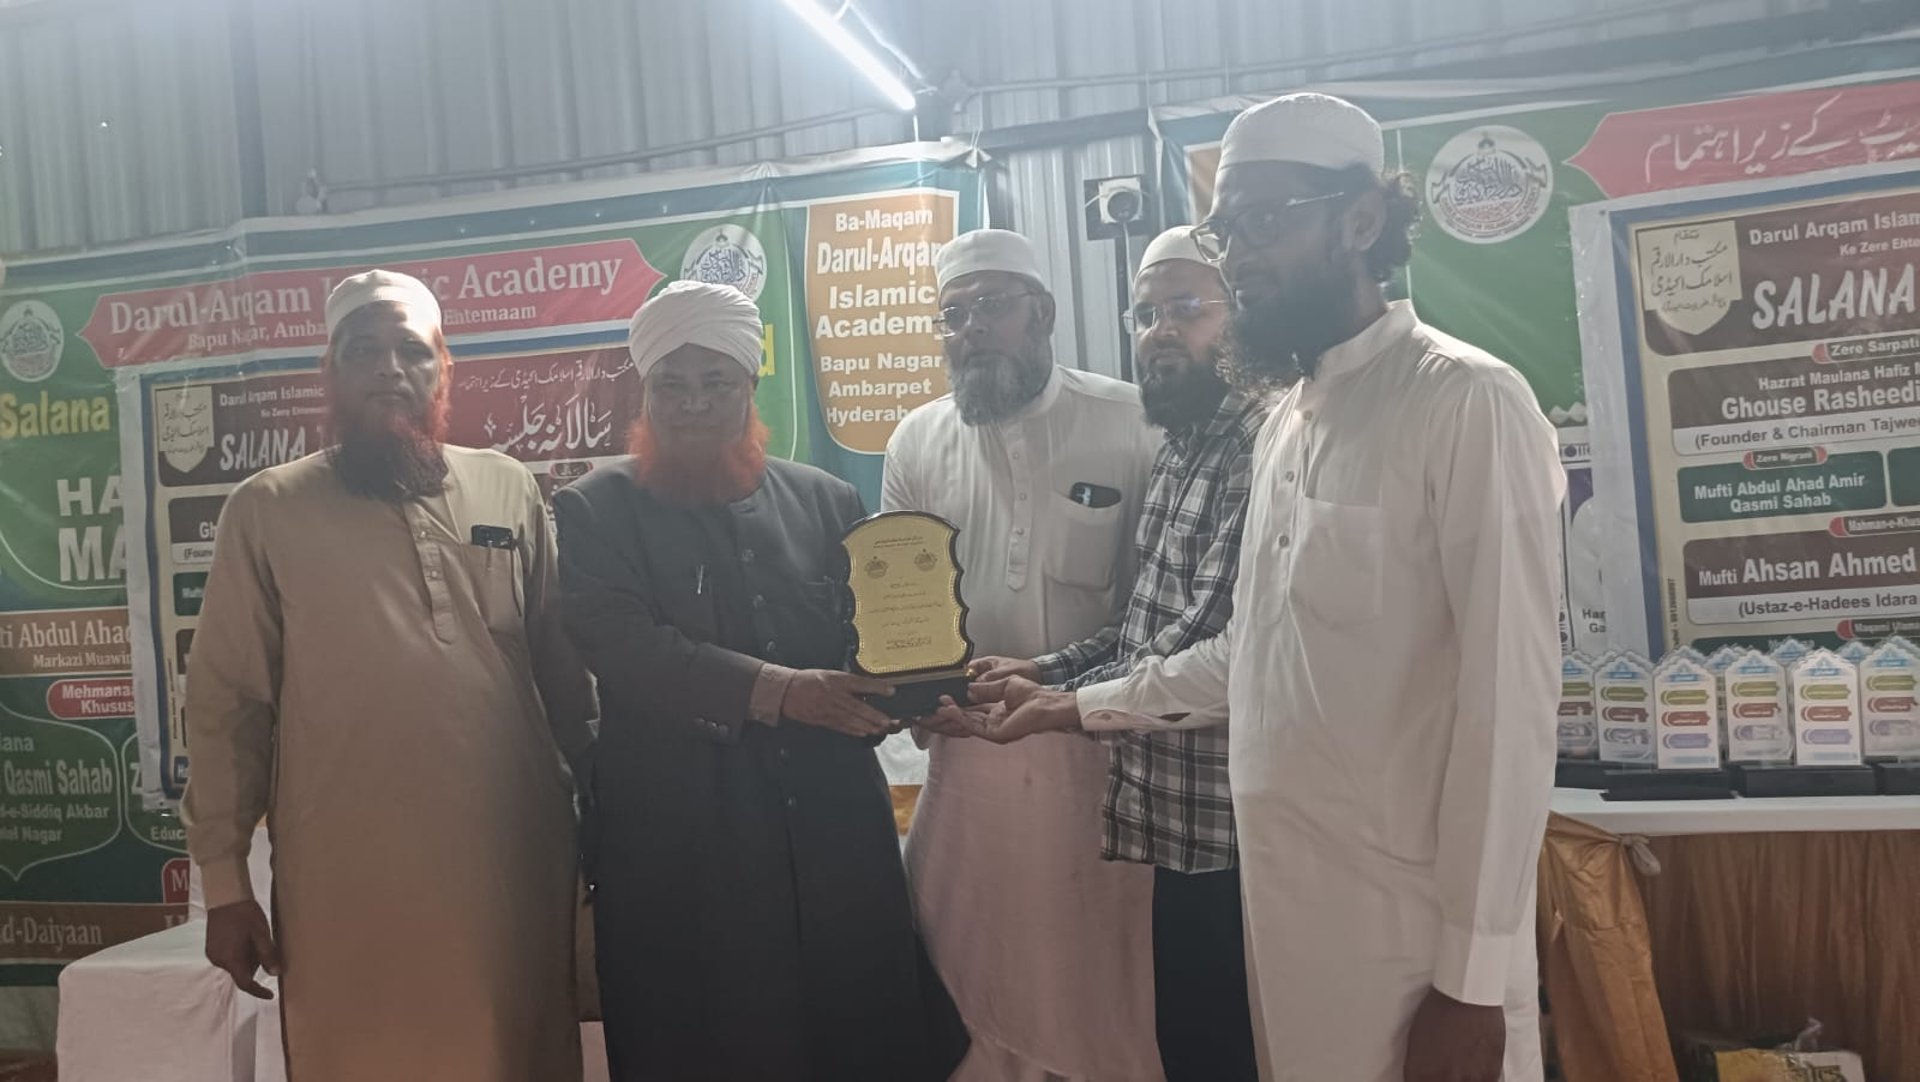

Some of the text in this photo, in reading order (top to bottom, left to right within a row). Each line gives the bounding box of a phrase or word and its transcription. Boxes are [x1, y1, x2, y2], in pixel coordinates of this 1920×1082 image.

[835, 208, 933, 233] Ba-Maqam
[1749, 223, 1799, 245] Darul
[1805, 218, 1868, 239] Arqam
[1839, 243, 1857, 256] Ke
[1860, 241, 1889, 253] Zere
[110, 286, 312, 334] Darul-Arqam
[457, 256, 622, 299] Academy
[829, 280, 936, 309] Islamic
[1752, 262, 1916, 330] SALANA
[815, 311, 943, 340] Academ
[820, 353, 943, 375] Bapu Nagar
[1831, 343, 1866, 358] Zere
[829, 378, 932, 398] Ambarpet
[1758, 376, 1806, 391] Hazrat
[1809, 368, 1870, 386] Maulana
[1874, 363, 1911, 377] Hafiz
[281, 385, 325, 399] Islamic
[0, 391, 110, 440] Salana
[1721, 395, 1806, 420] Ghouse
[219, 426, 306, 471] SALANA
[1694, 430, 1767, 450] (Founder
[1773, 427, 1784, 441] &
[1788, 421, 1866, 440] Chairman
[1694, 472, 1865, 500] Mufti Abdul Ahad Amir
[1730, 492, 1832, 513] Qasmi Sahab
[1699, 547, 1917, 587] Mufti Ahsan Ahmed
[1738, 593, 1918, 618] (Ustaz-e-Hadees Idara
[19, 621, 79, 648] Abdul
[33, 652, 83, 668] Markazi
[5, 758, 113, 795] Qasmi Sahab
[66, 803, 110, 819] Akbar
